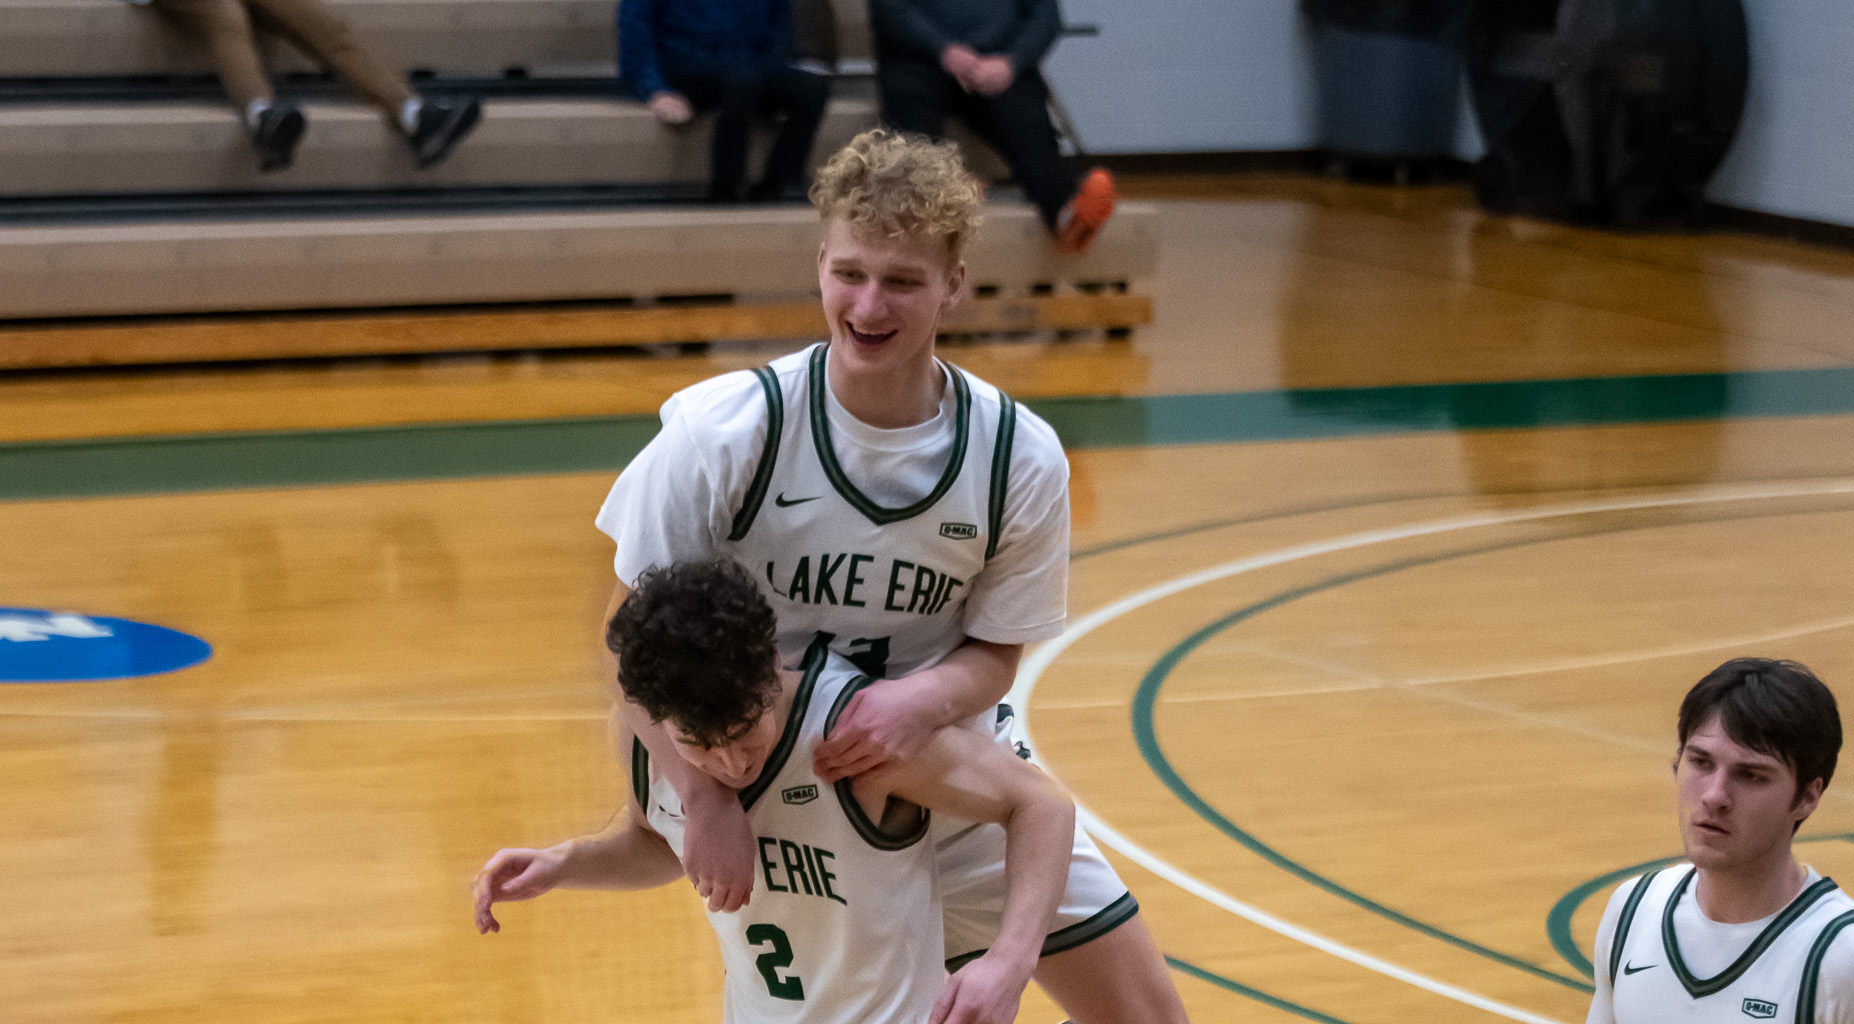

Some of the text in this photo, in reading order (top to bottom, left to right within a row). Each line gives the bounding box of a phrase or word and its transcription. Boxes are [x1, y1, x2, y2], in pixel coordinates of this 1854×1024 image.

[884, 558, 964, 615] ERIE
[757, 836, 848, 906] ERIE
[745, 923, 805, 1001] 2
[1746, 1001, 1773, 1015] G-MAC
